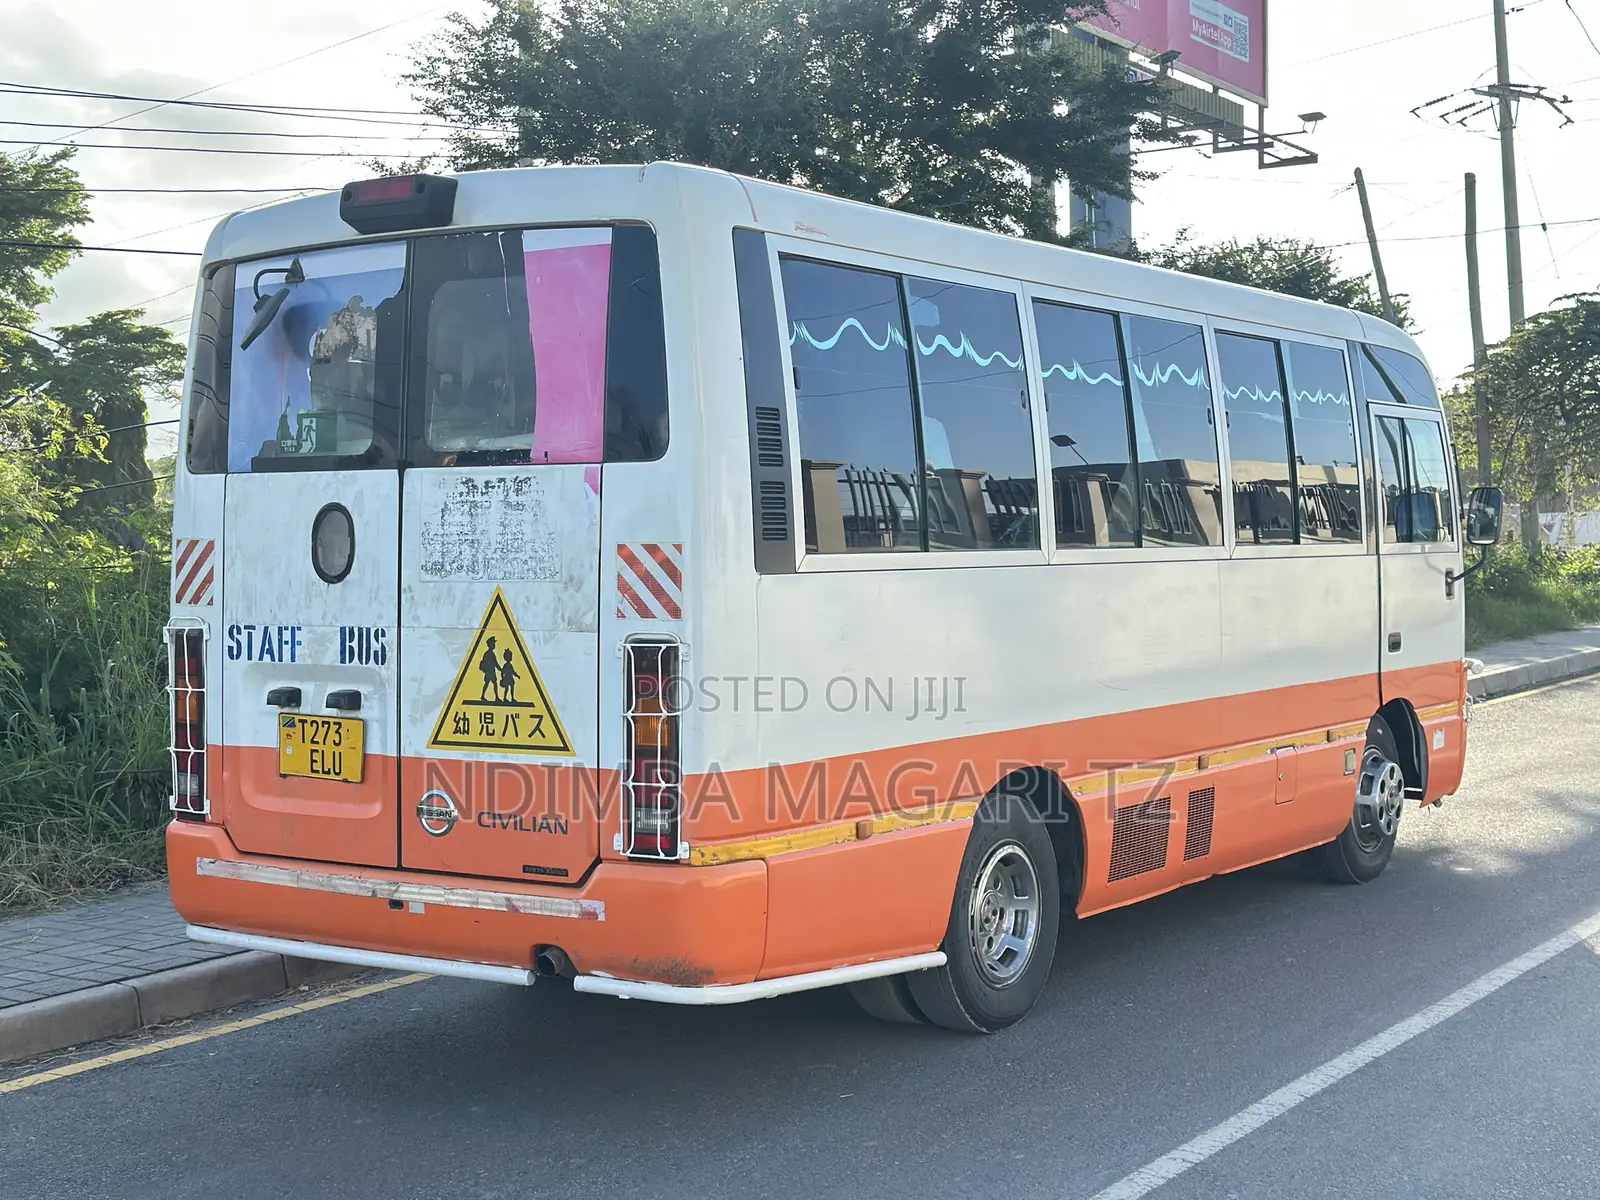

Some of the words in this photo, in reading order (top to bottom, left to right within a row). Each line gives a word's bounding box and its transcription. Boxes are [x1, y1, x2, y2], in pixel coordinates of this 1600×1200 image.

[227, 624, 302, 663] STAFF
[339, 626, 387, 666] BUS
[298, 718, 342, 747] T273
[452, 711, 546, 739] 幼児バス
[310, 749, 342, 776] ELU
[419, 807, 452, 818] NISSAN
[477, 811, 569, 835] CIVILIAN
